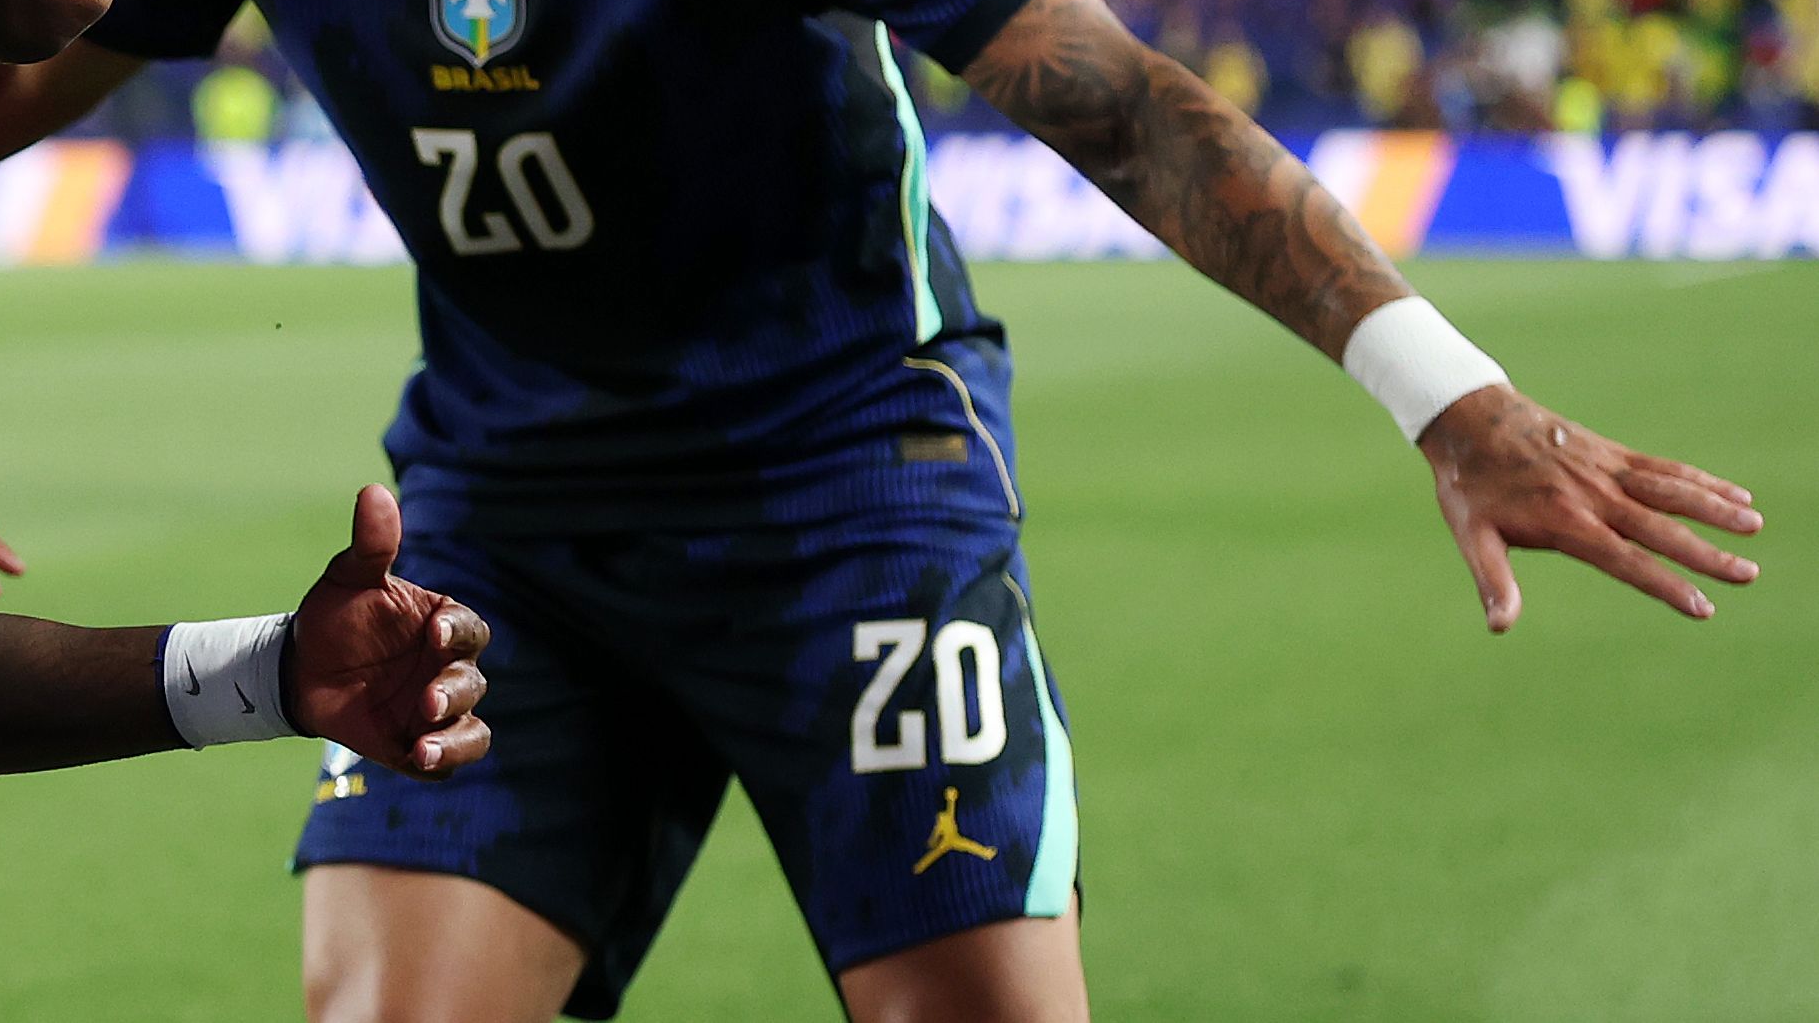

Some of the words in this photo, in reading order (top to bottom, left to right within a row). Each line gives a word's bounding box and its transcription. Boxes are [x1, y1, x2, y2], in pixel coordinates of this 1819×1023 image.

[431, 63, 540, 92] BRASIL
[411, 127, 595, 257] 20
[850, 618, 1008, 775] 20
